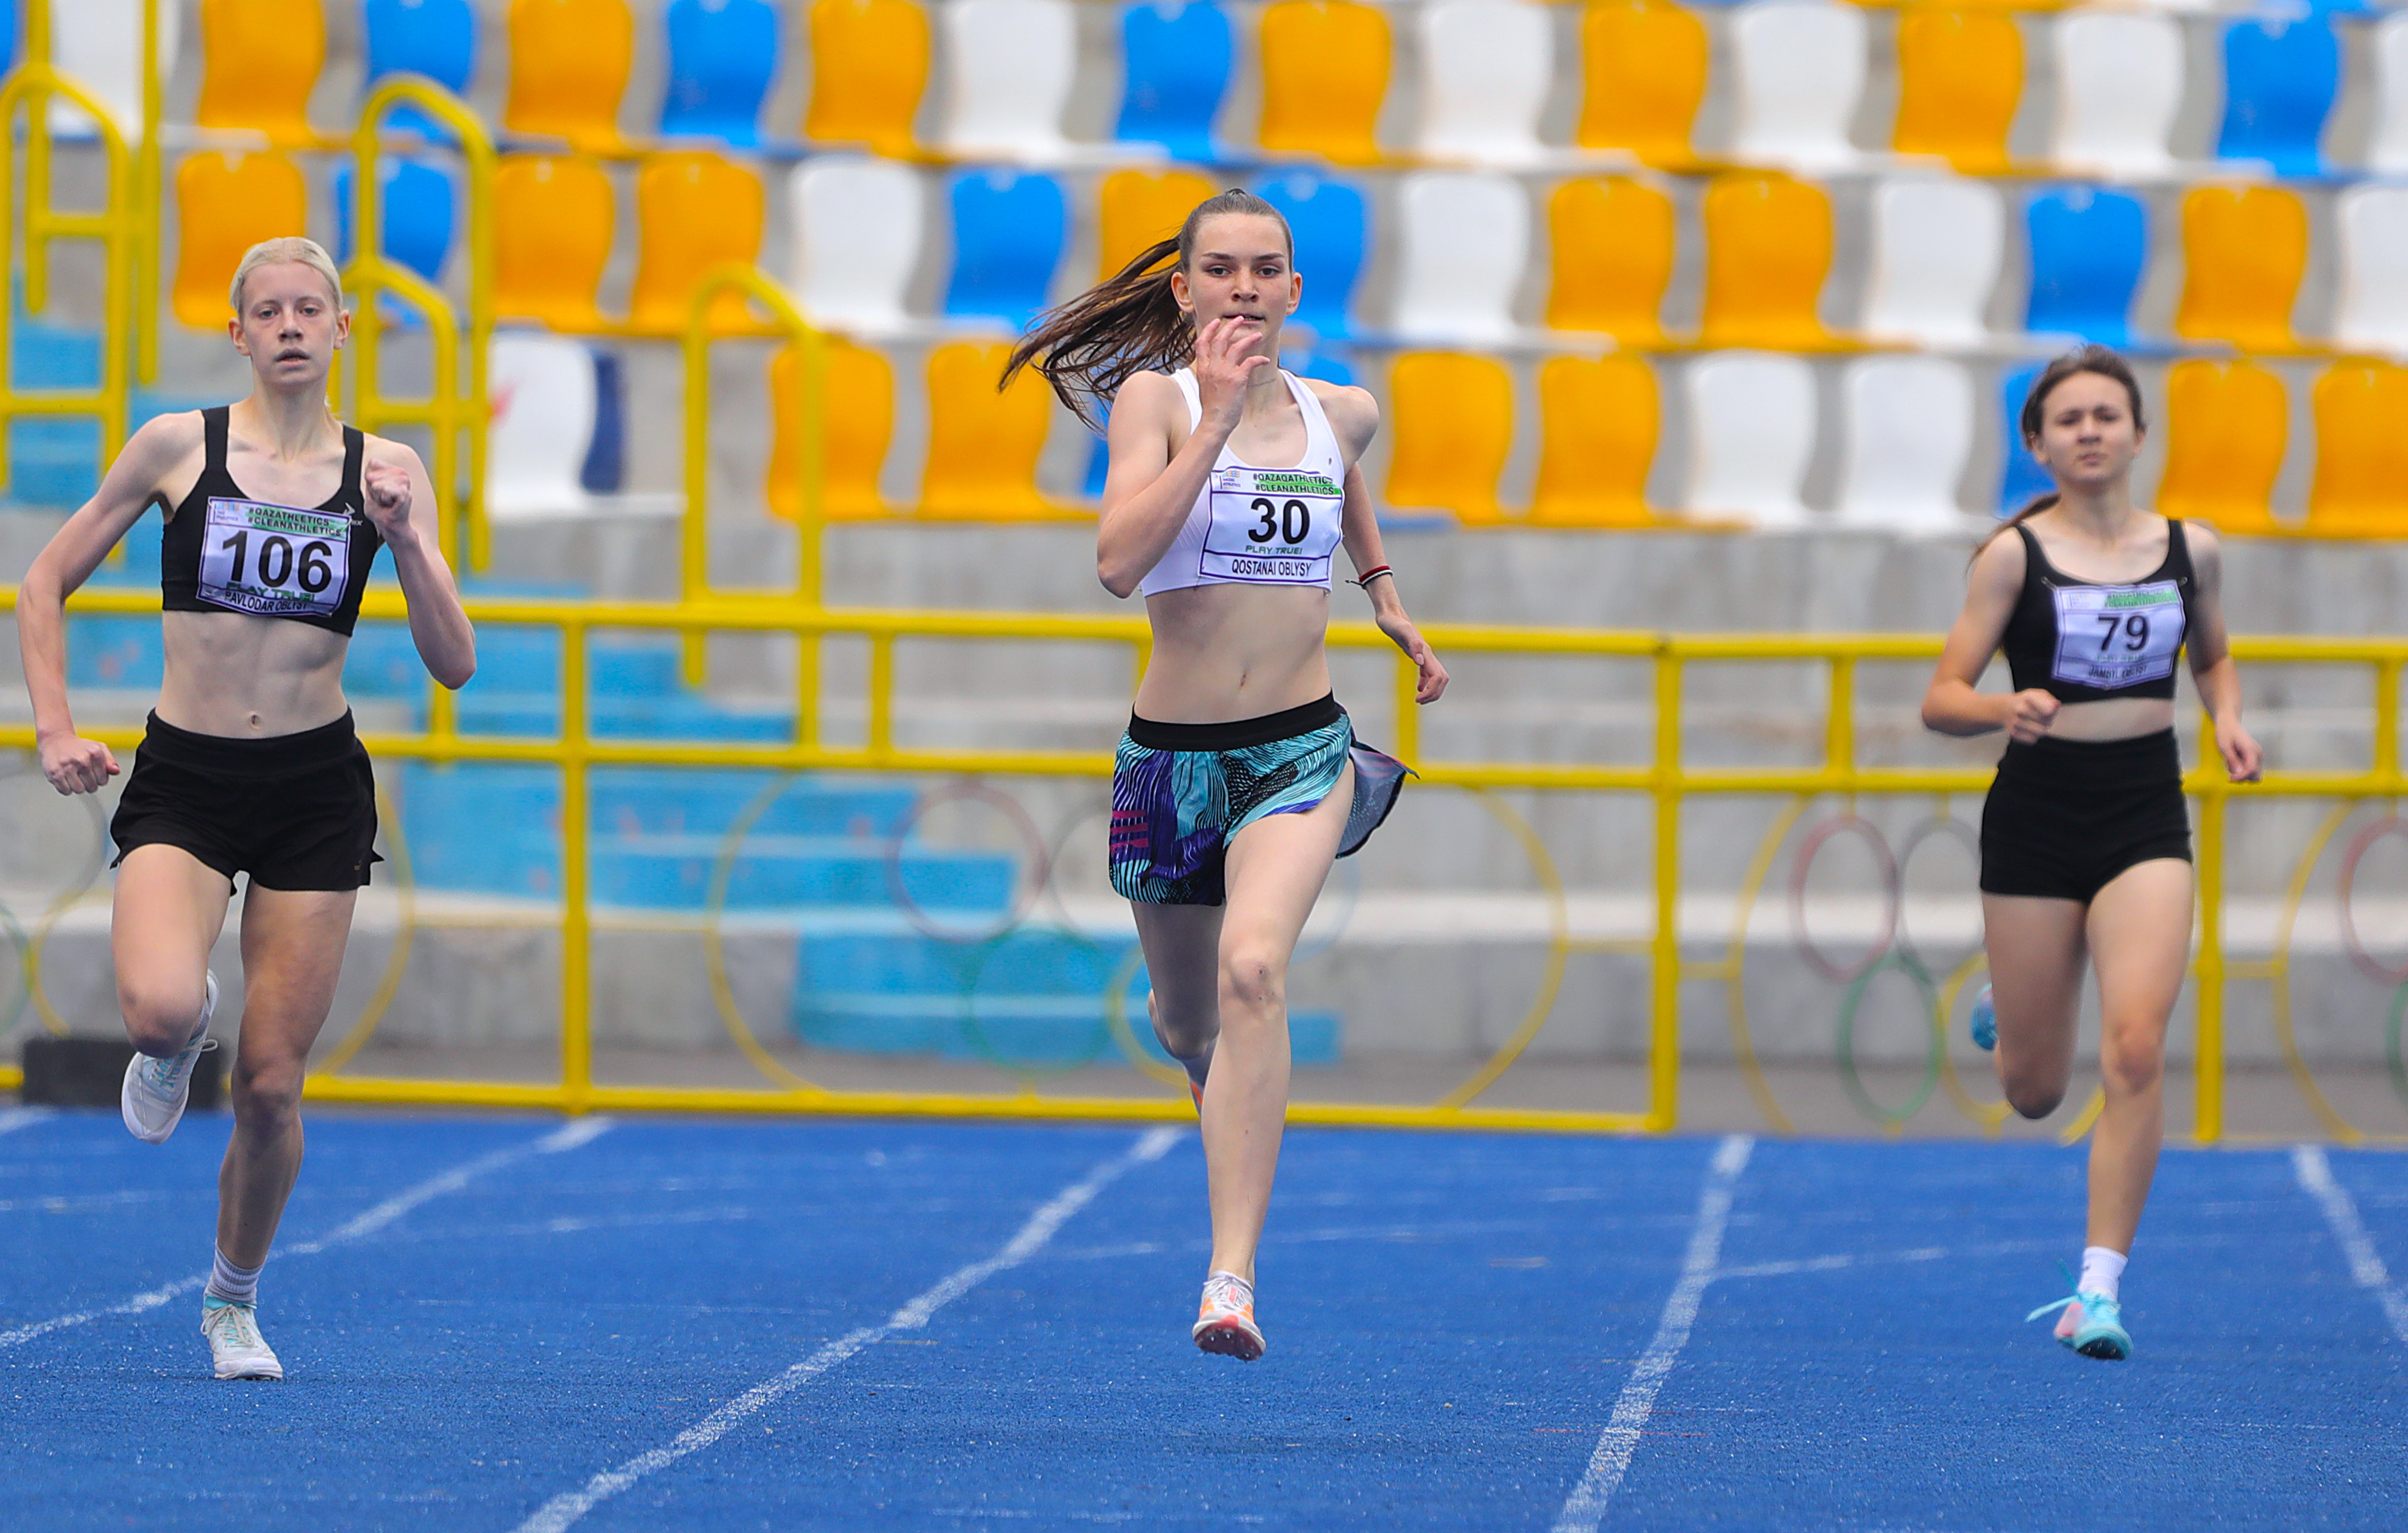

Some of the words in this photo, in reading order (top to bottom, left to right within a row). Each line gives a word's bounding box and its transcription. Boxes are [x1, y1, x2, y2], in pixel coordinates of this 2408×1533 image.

[1255, 484, 1334, 495] #CLEANATHLETICS
[247, 516, 342, 537] #CLEANATHLETICS
[1248, 498, 1310, 544] 30
[1245, 545, 1272, 554] PLAY
[1276, 546, 1303, 554] TRUE!
[223, 530, 332, 593] 106
[1231, 558, 1276, 575] QOSTANAI
[1278, 561, 1312, 576] OBLYSY
[225, 590, 275, 612] PAVLODAR
[2098, 615, 2149, 651] 79
